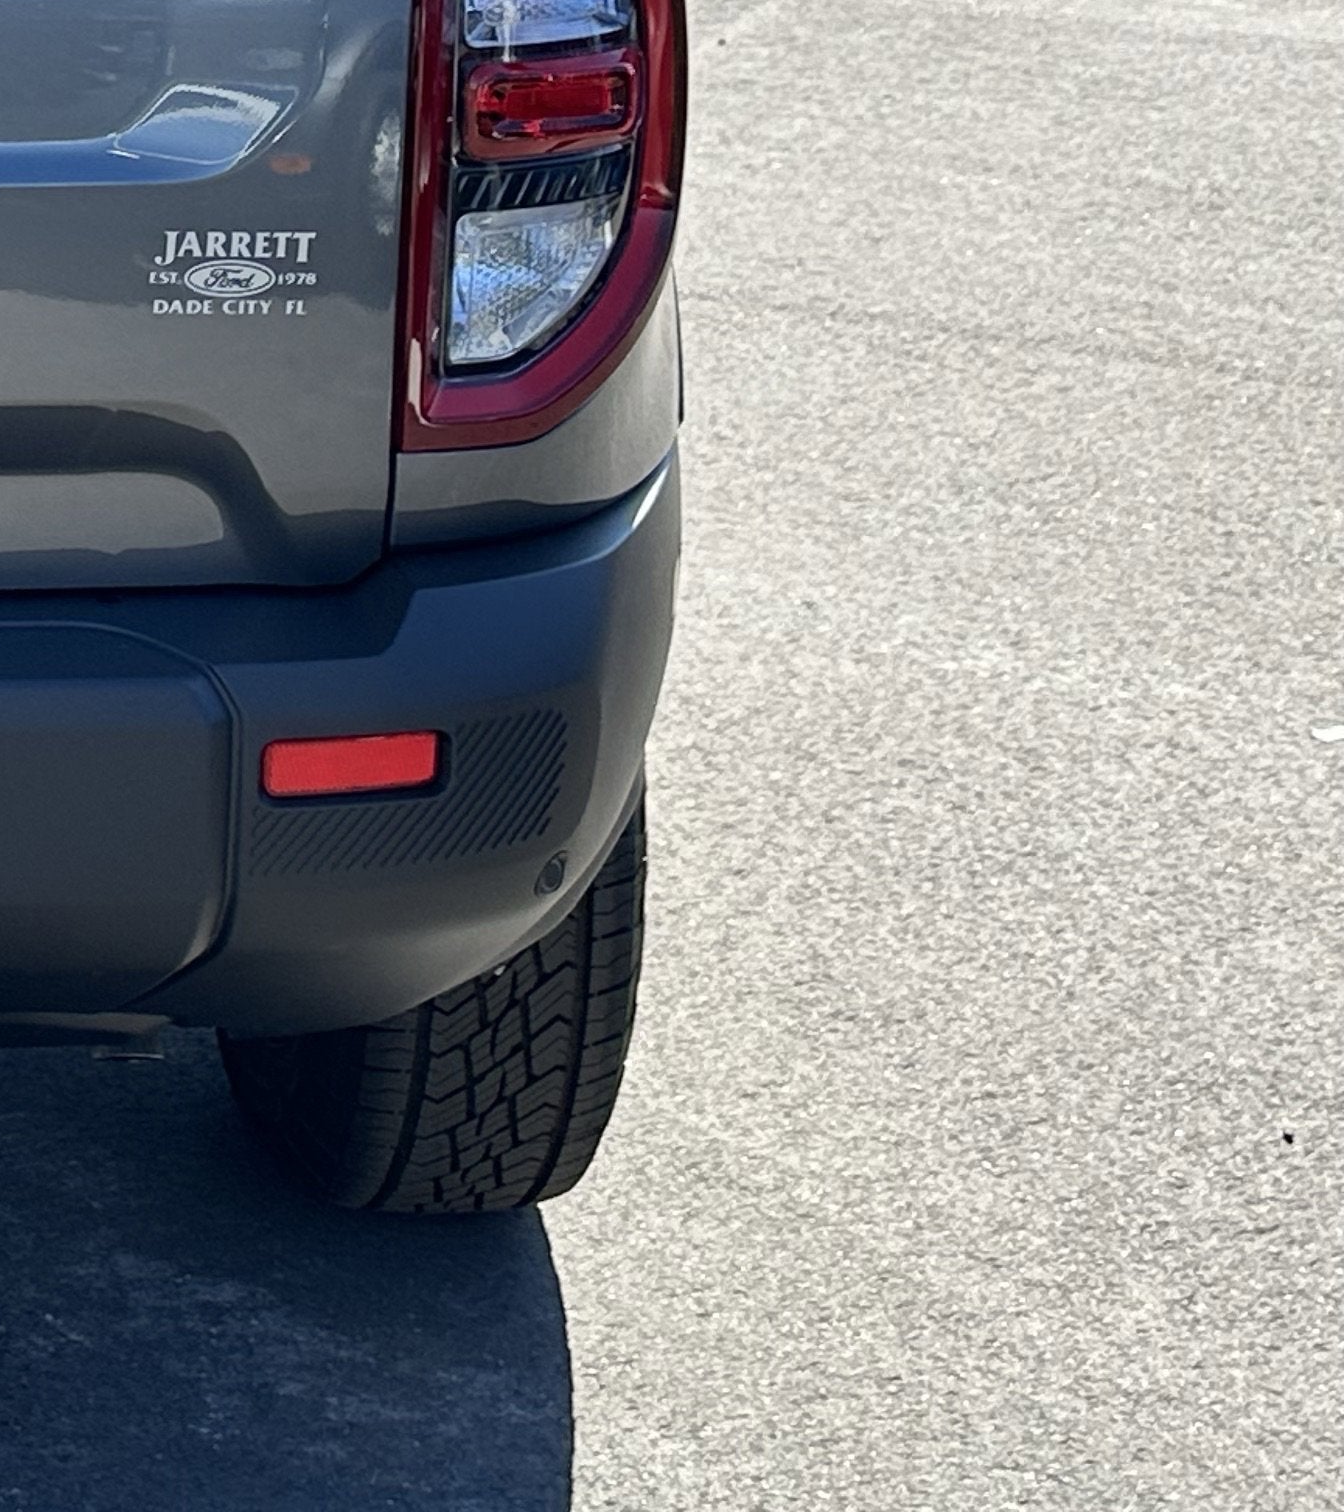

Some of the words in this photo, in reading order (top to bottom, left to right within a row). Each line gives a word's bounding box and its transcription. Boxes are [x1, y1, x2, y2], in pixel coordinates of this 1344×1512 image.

[154, 230, 317, 266] JARRETT
[149, 271, 182, 285] EST.
[204, 268, 256, 288] Ford
[278, 272, 317, 285] 1978
[152, 299, 213, 315] DADE
[222, 299, 272, 316] CITY
[285, 300, 307, 316] FL
